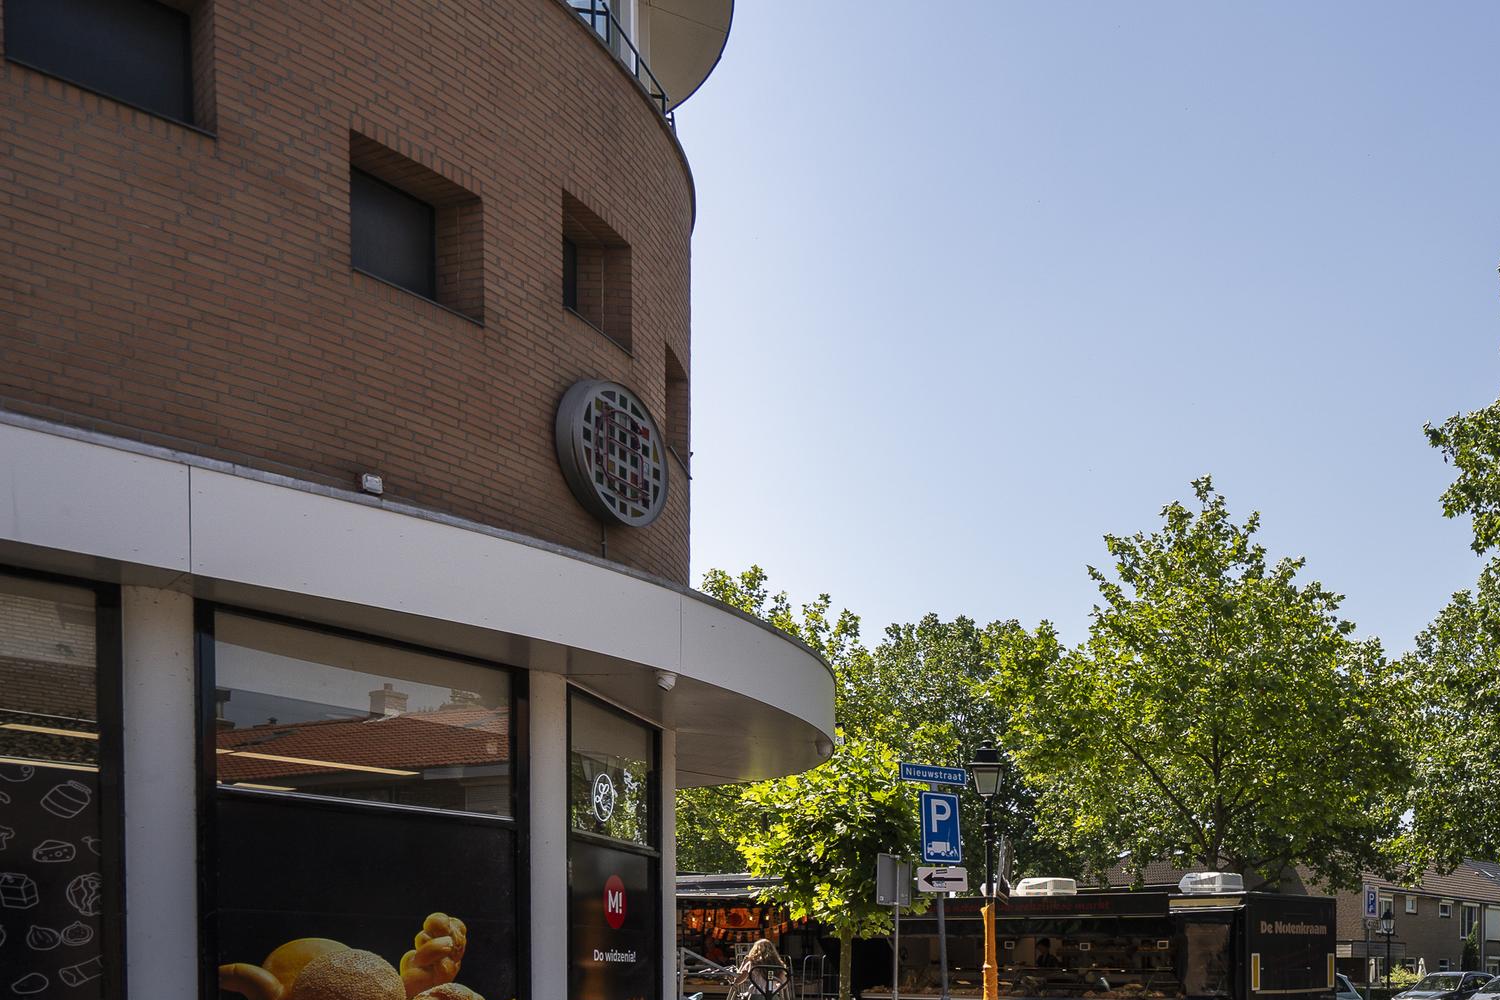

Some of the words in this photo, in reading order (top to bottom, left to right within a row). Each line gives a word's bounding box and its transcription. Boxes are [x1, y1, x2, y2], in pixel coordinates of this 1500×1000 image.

[905, 767, 962, 781] Nieuwstraat
[930, 798, 951, 833] P
[608, 889, 623, 914] M!
[1260, 920, 1273, 934] De
[1274, 921, 1327, 935] Notenkraam
[593, 949, 604, 961] Do
[605, 949, 636, 962] widzenia!
